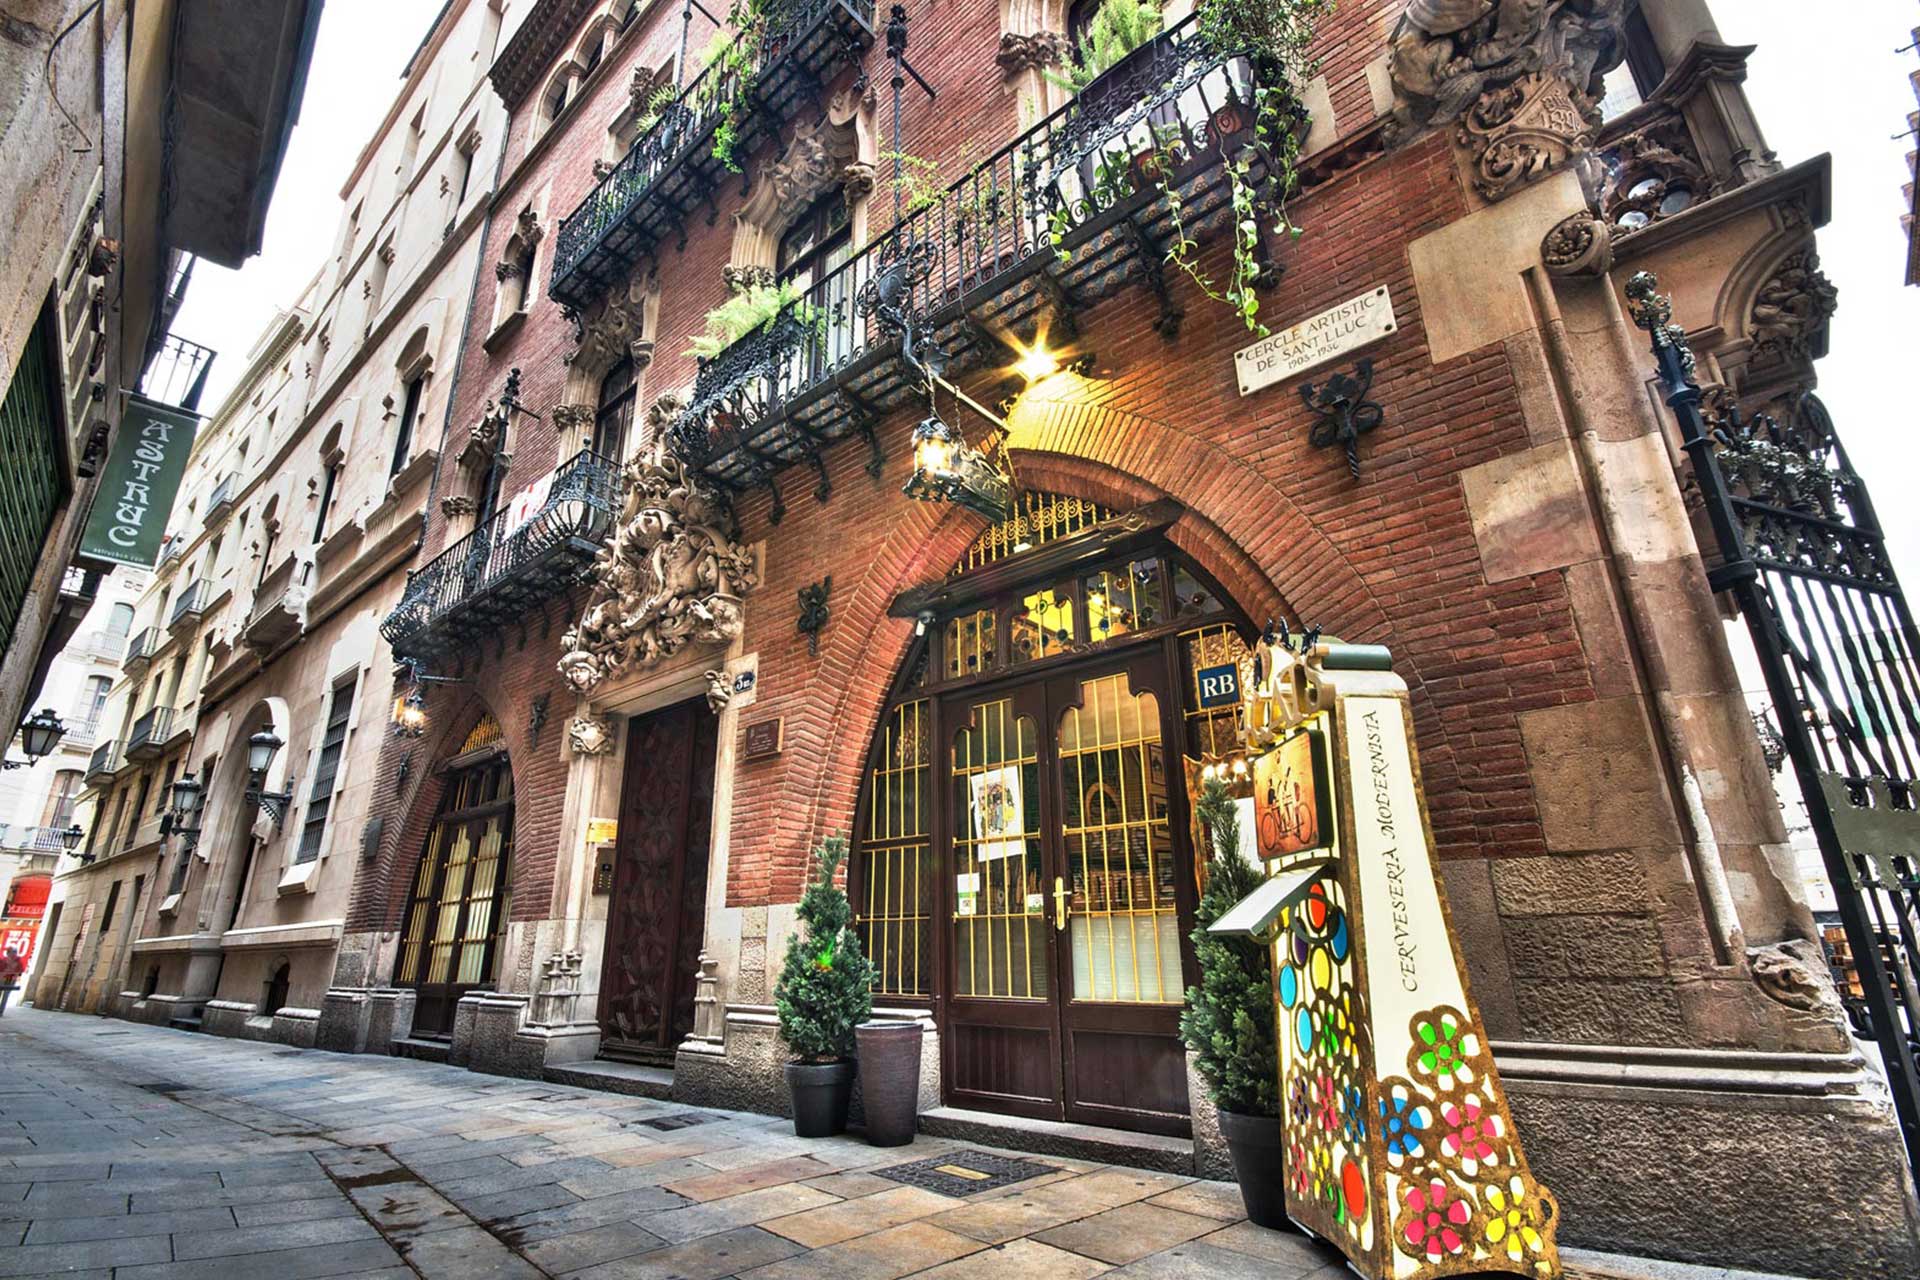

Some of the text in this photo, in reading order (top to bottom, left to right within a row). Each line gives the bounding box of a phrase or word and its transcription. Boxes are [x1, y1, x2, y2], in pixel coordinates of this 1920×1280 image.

[1245, 327, 1301, 361] CERCLE
[1256, 315, 1367, 373] DE SANT LLUC
[108, 418, 173, 547] ASTRUC
[1202, 674, 1235, 698] RB
[1362, 710, 1418, 992] CERVESERIA MODERNISTA
